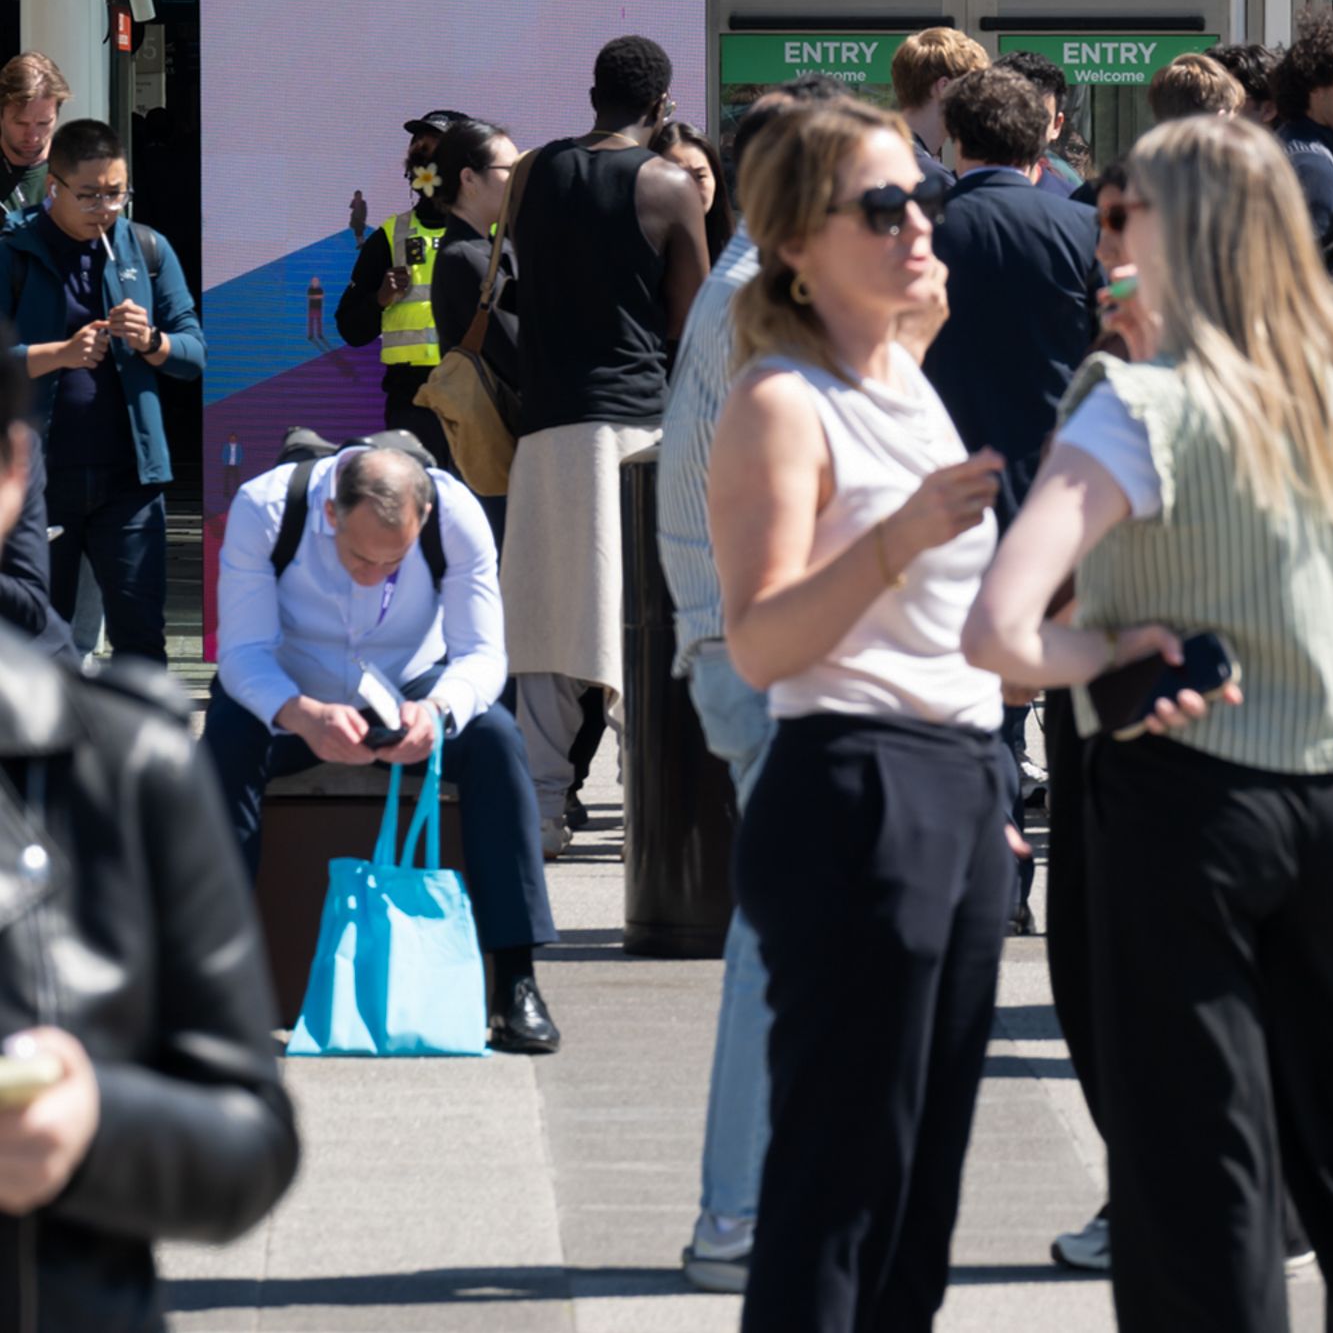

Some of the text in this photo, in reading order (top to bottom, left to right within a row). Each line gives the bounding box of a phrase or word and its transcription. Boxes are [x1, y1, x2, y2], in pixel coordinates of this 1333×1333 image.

[784, 41, 879, 63] ENTRY
[1063, 42, 1157, 64] ENTRY
[1074, 69, 1145, 82] Welcome
